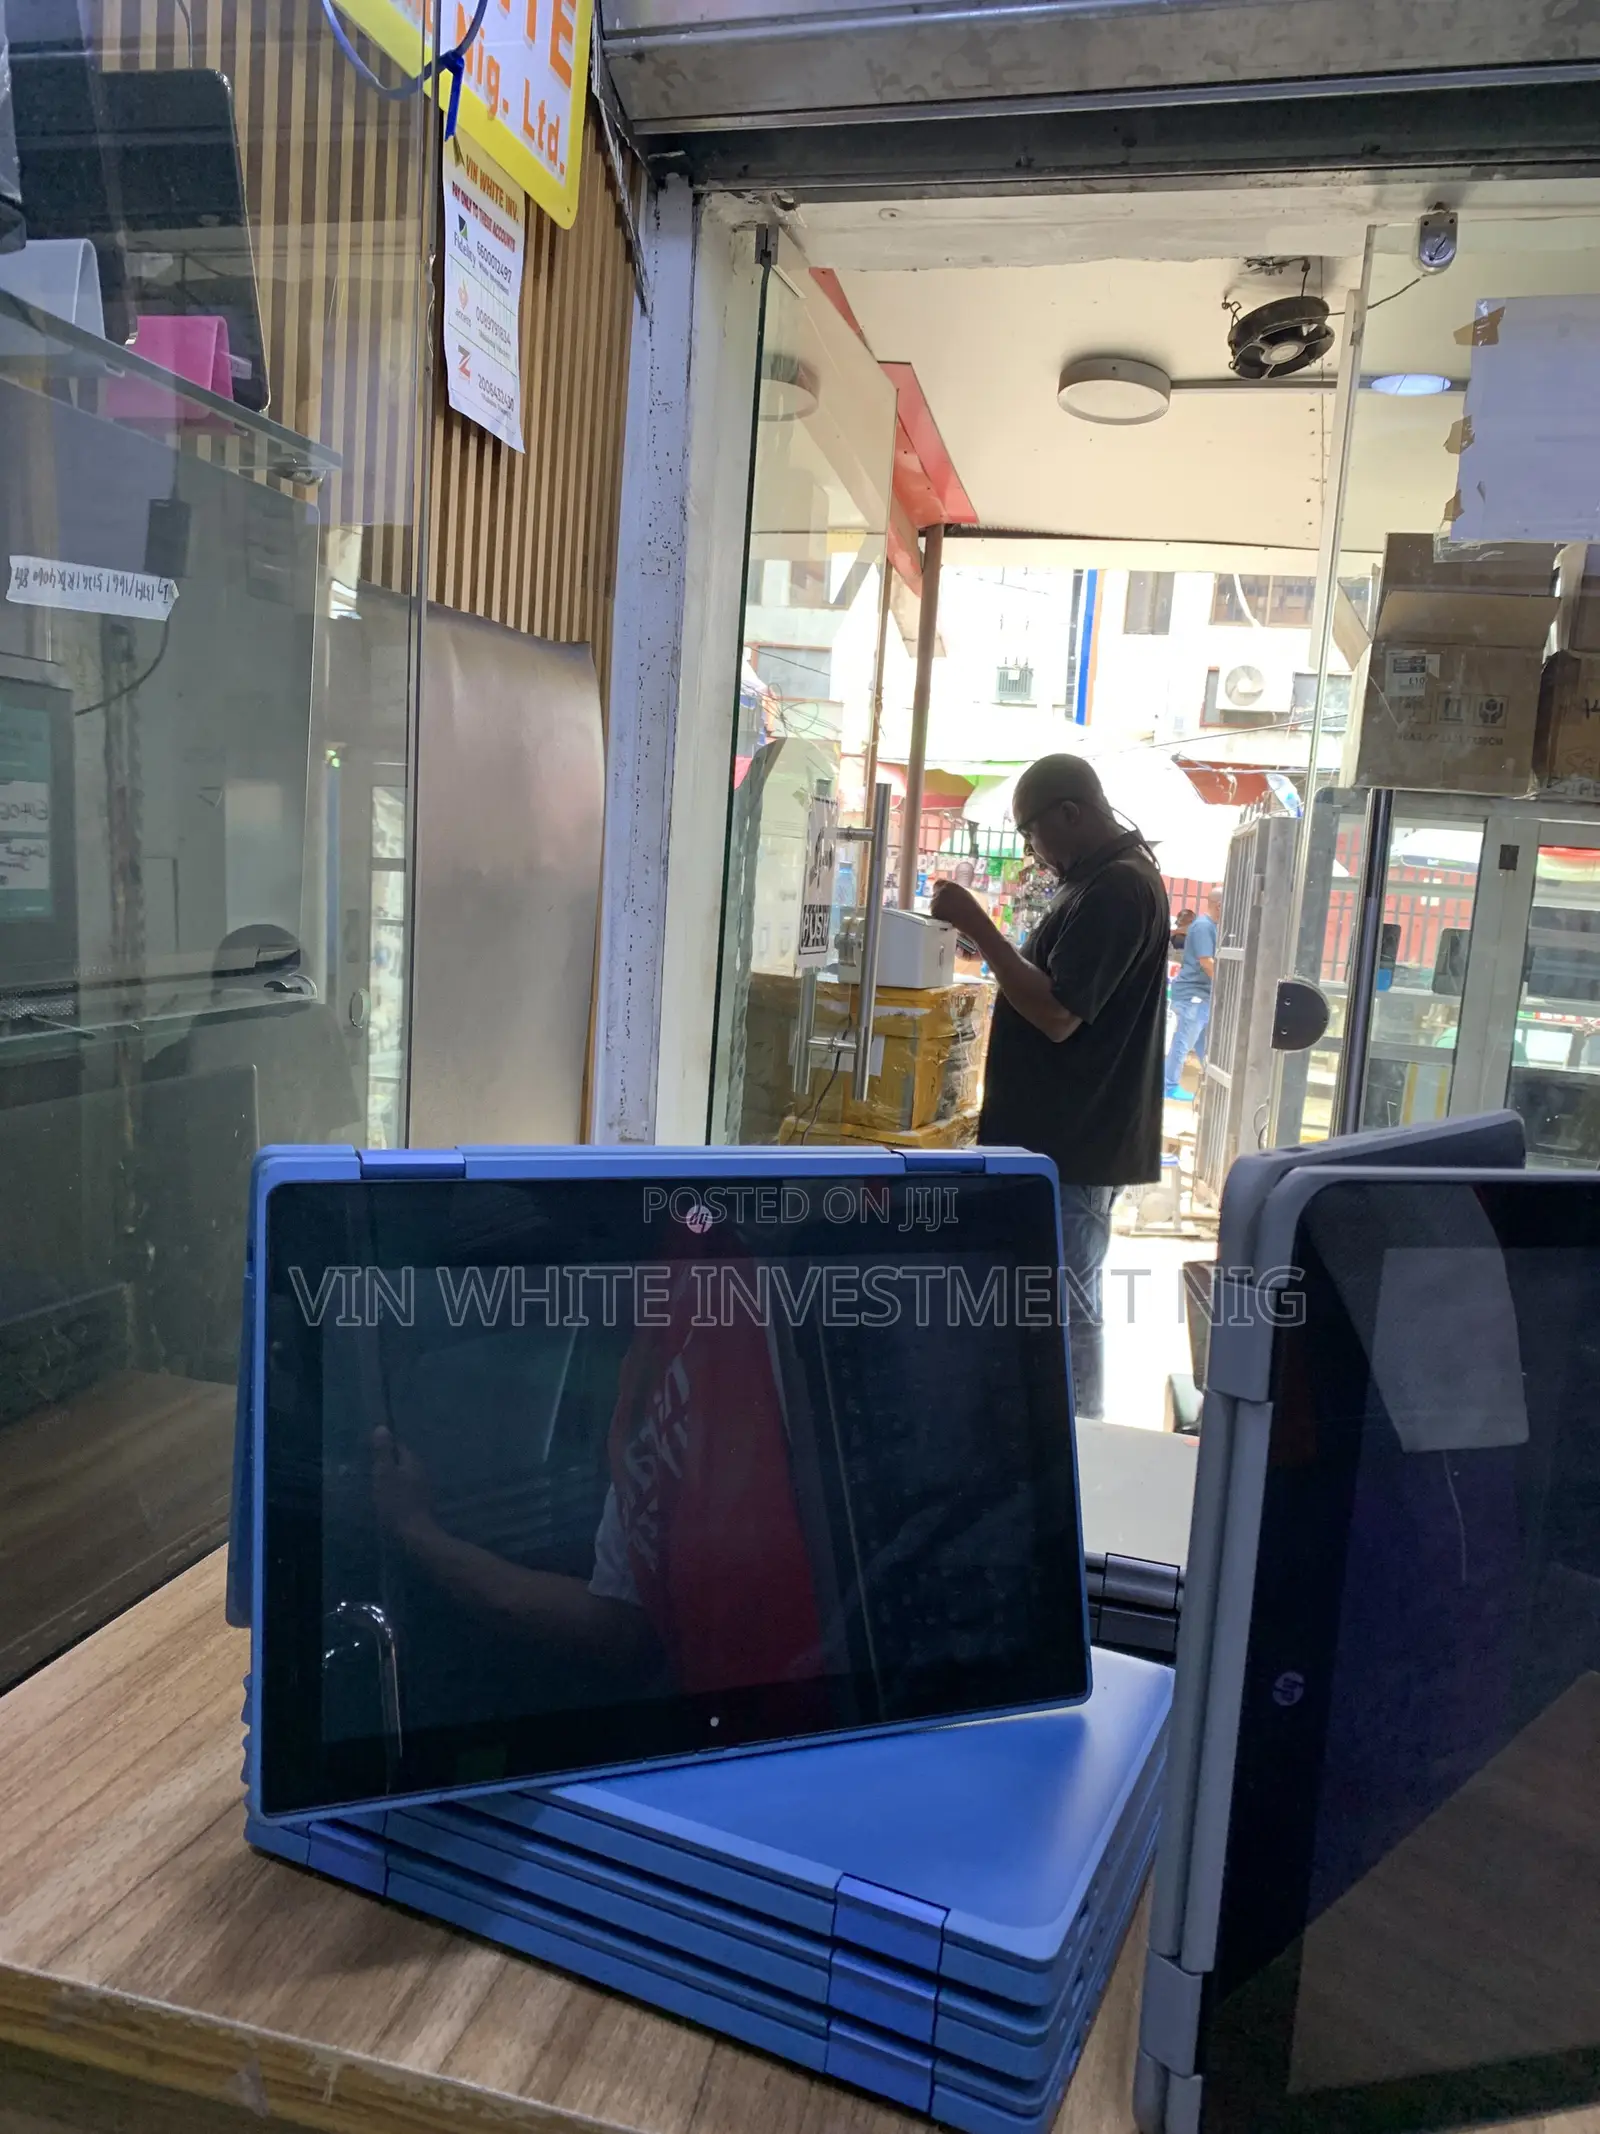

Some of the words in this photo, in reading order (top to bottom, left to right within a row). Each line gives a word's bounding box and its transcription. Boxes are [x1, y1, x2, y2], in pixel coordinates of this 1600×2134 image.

[522, 76, 565, 176] Ltd.
[465, 153, 478, 185] VIN
[479, 170, 504, 208] WHITE
[505, 192, 519, 222] INV.
